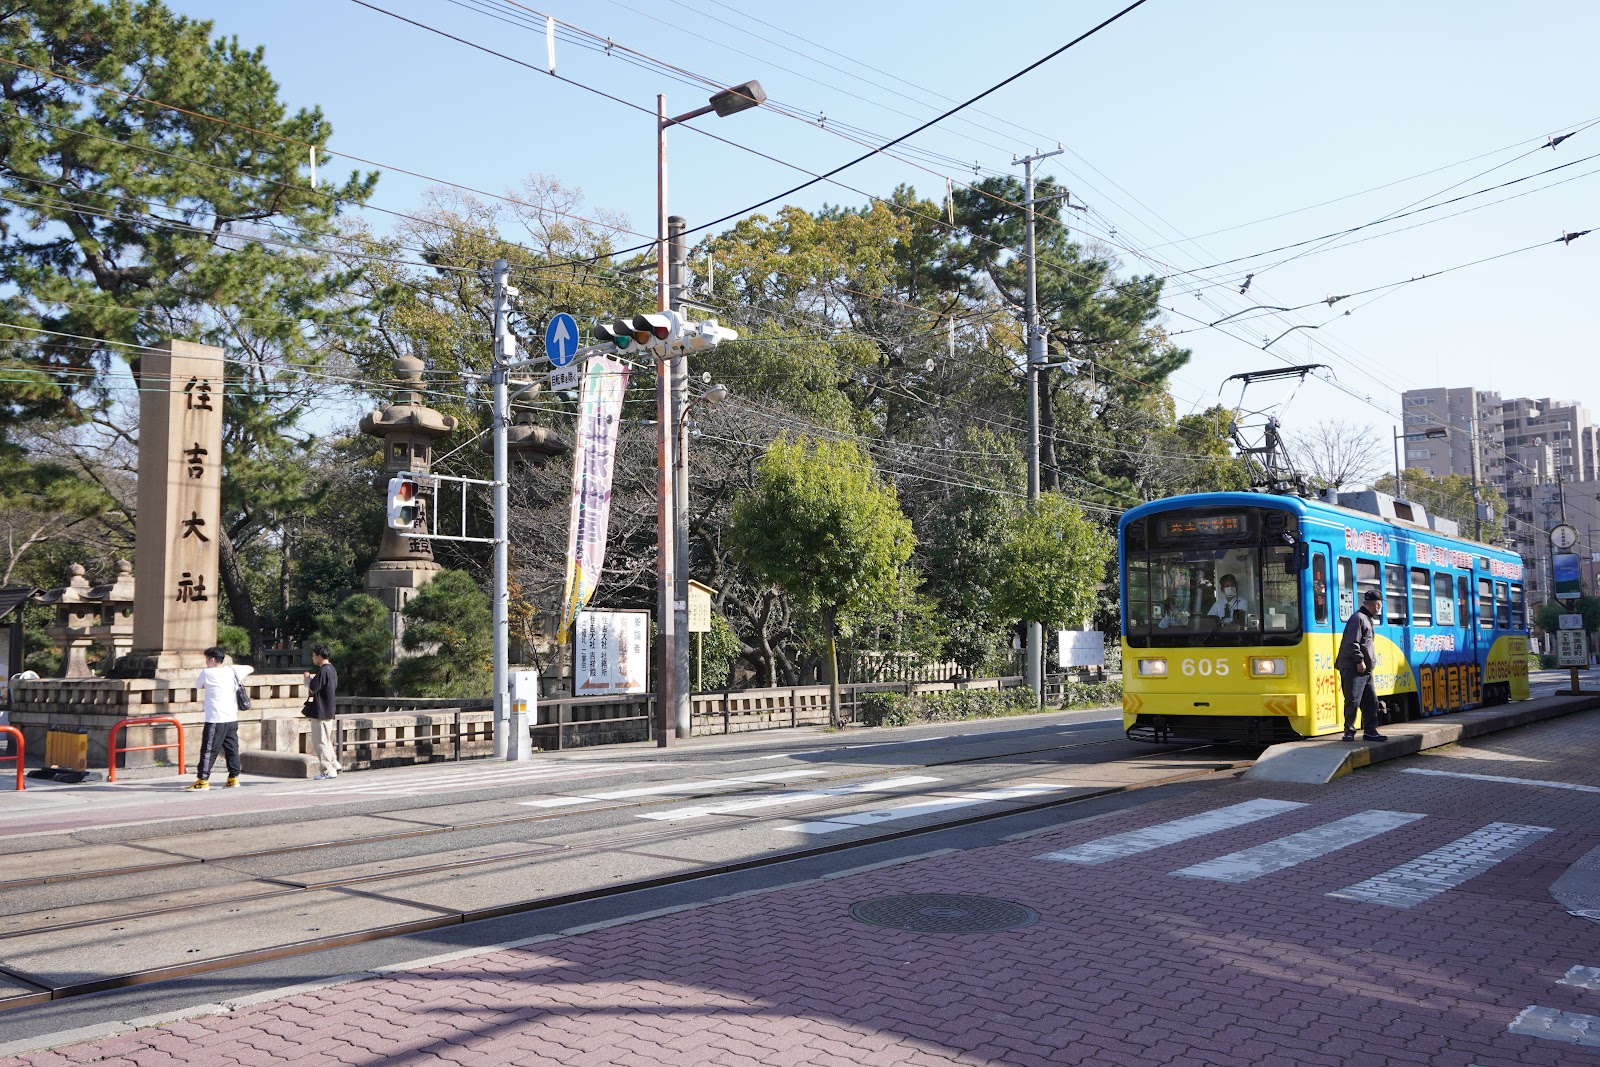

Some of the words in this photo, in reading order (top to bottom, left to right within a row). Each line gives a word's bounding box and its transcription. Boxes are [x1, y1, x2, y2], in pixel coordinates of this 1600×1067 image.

[551, 371, 577, 387] 自転車を除く
[175, 375, 213, 603] 住吉大社
[1345, 526, 1390, 557] 安心の質屋さん
[1345, 592, 1352, 603] 出口
[1438, 600, 1446, 610] 入口
[1341, 605, 1352, 616] EXIT
[1181, 658, 1230, 677] 605
[1314, 652, 1332, 670] テレビ
[1419, 662, 1483, 715] 岡崎屋質店
